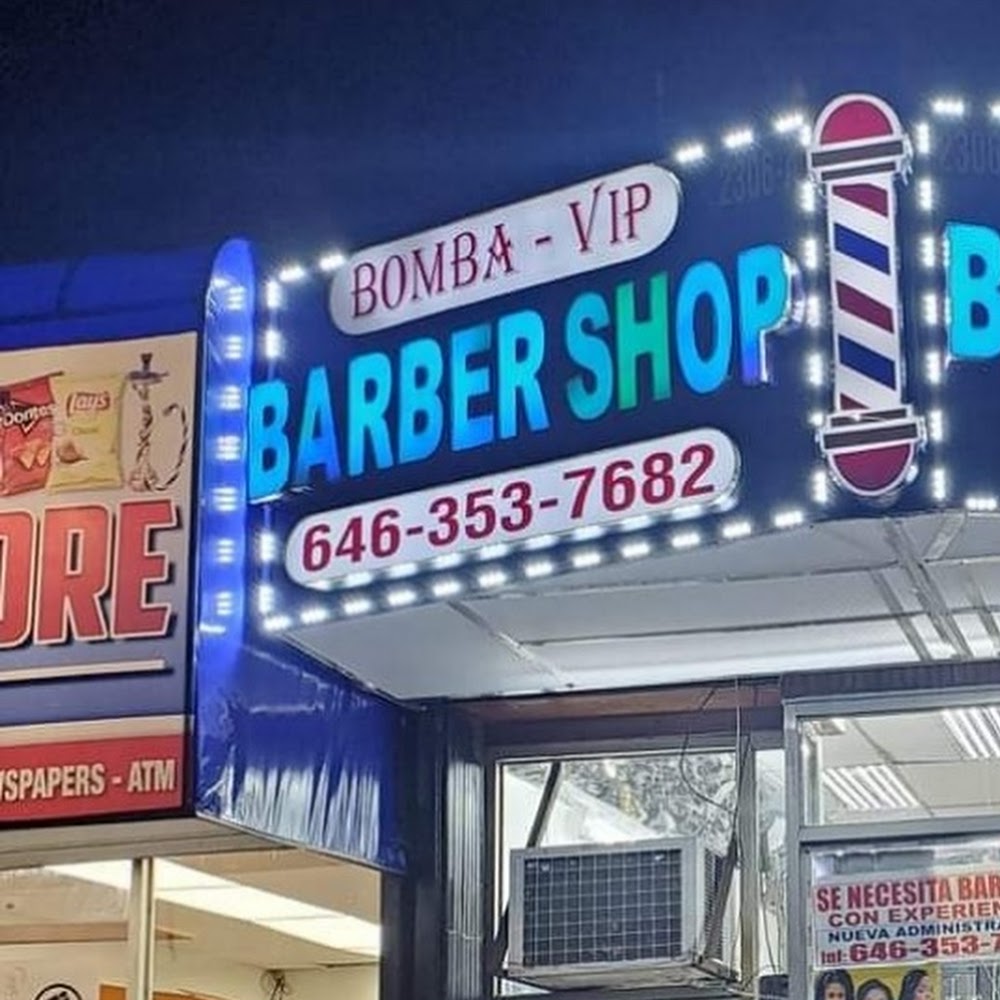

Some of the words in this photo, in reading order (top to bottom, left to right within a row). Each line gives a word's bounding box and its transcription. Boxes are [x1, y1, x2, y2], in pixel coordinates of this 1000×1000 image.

[351, 223, 515, 319] BOMBA
[569, 180, 652, 255] VIP
[247, 309, 551, 504] BARBER
[564, 243, 792, 424] SHOP
[301, 442, 716, 573] 646-353-7682
[127, 758, 176, 793] ATM
[817, 885, 842, 913] SE
[848, 877, 952, 910] NECESITA
[828, 911, 880, 928] CON
[828, 928, 889, 943] NUEVA
